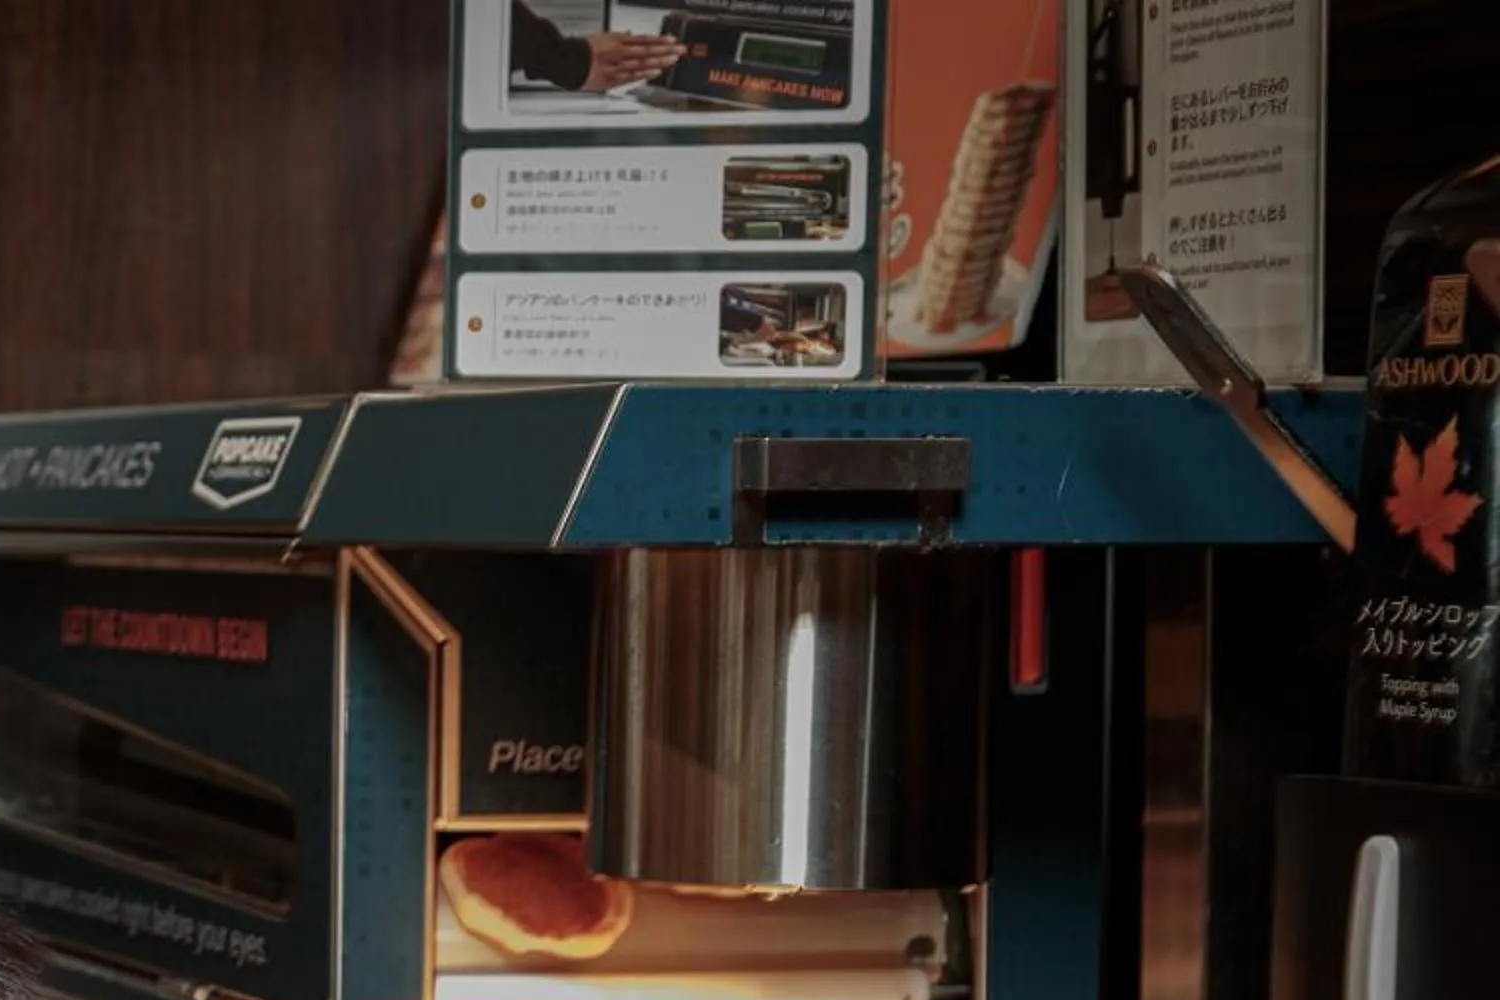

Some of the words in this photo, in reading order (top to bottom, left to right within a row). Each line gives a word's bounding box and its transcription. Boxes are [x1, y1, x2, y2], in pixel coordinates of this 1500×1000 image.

[1373, 353, 1500, 387] ASHWOOD
[1361, 627, 1492, 660] 入りトッピング
[1380, 673, 1429, 698] Topping
[1430, 676, 1460, 695] with
[1379, 698, 1418, 720] Maple
[1419, 700, 1458, 723] Syrup
[488, 738, 584, 774] Place
